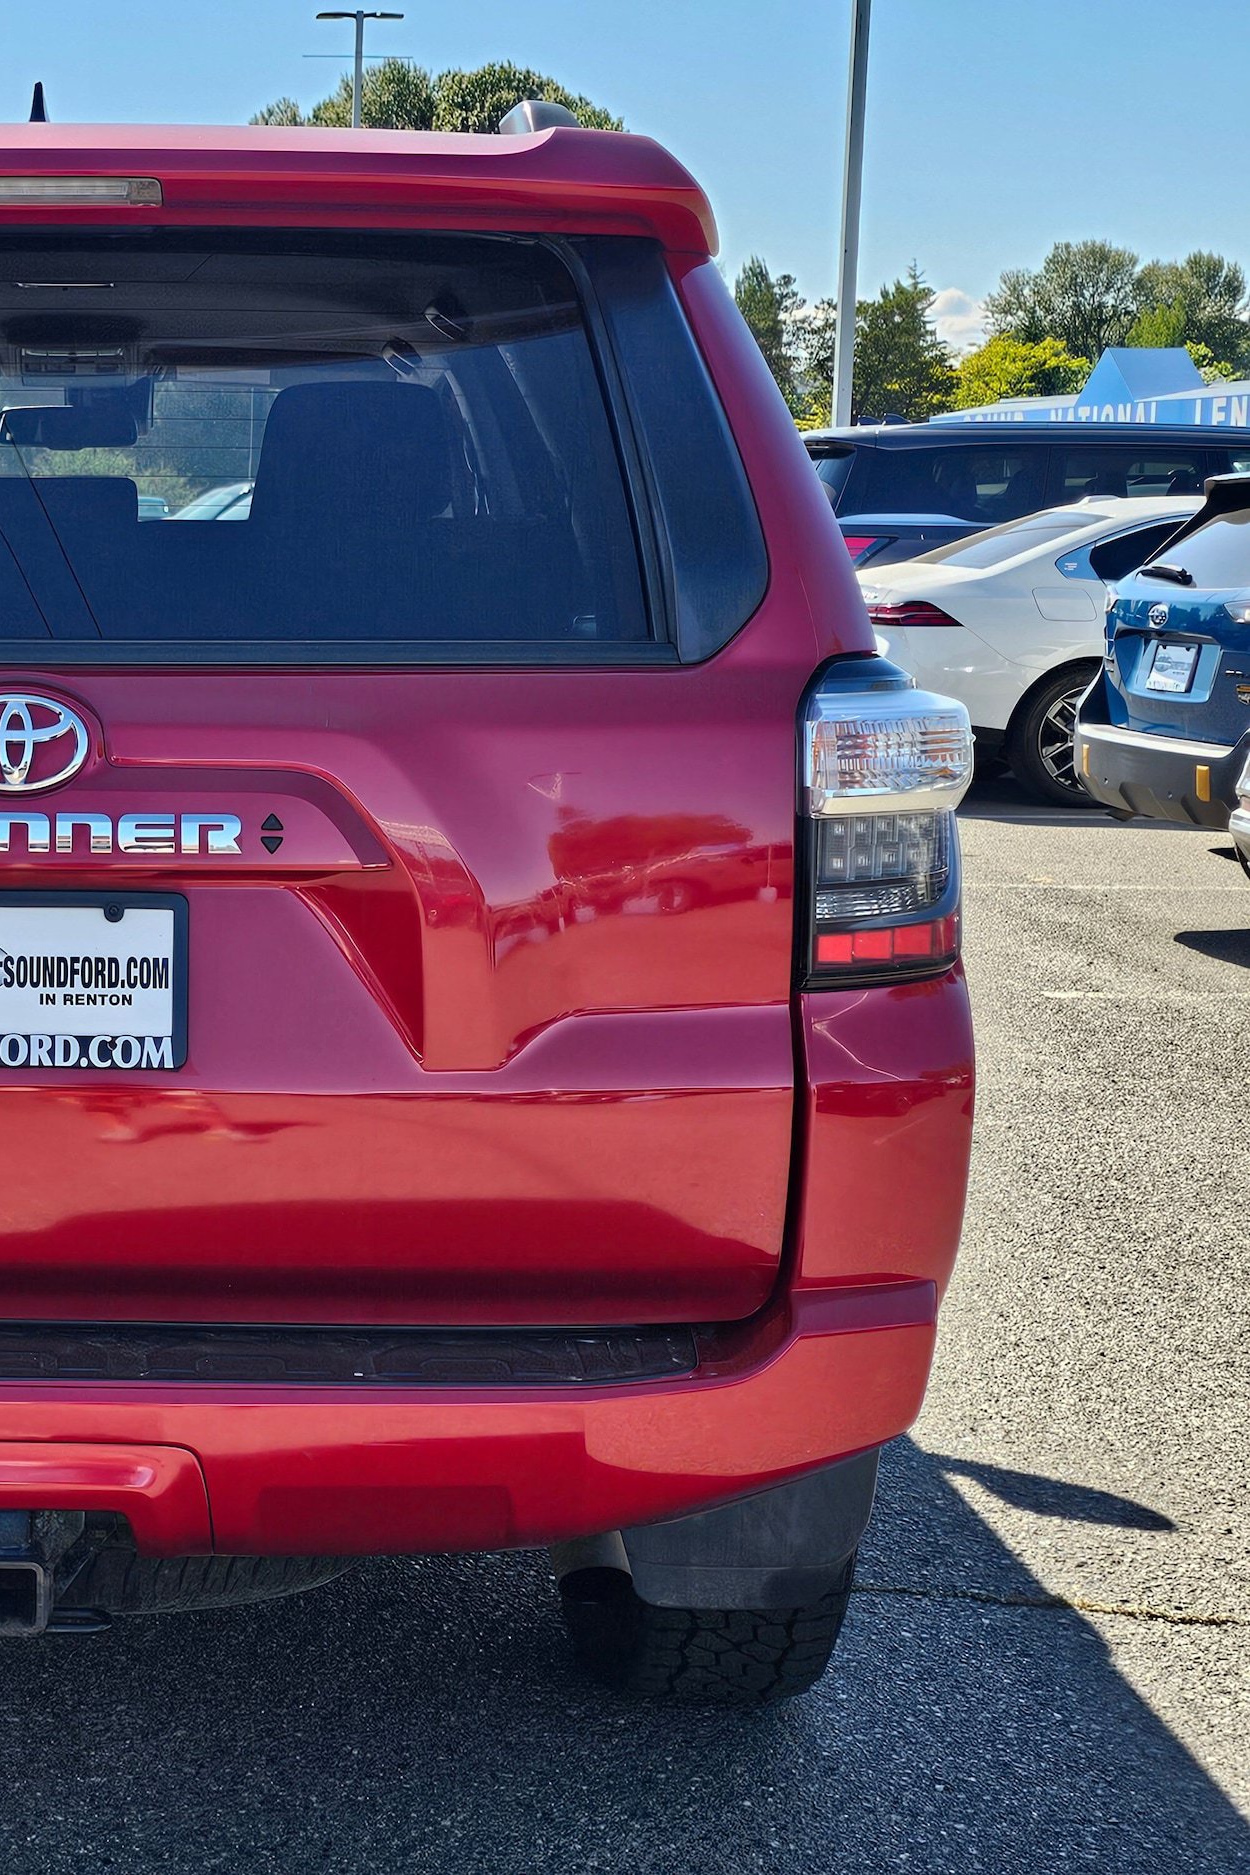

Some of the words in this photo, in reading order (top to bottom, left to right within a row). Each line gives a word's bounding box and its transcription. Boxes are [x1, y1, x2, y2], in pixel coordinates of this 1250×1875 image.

[2, 956, 169, 989] SOUNDFORD.COM
[39, 993, 56, 1006] IN
[62, 993, 133, 1006] RENTON
